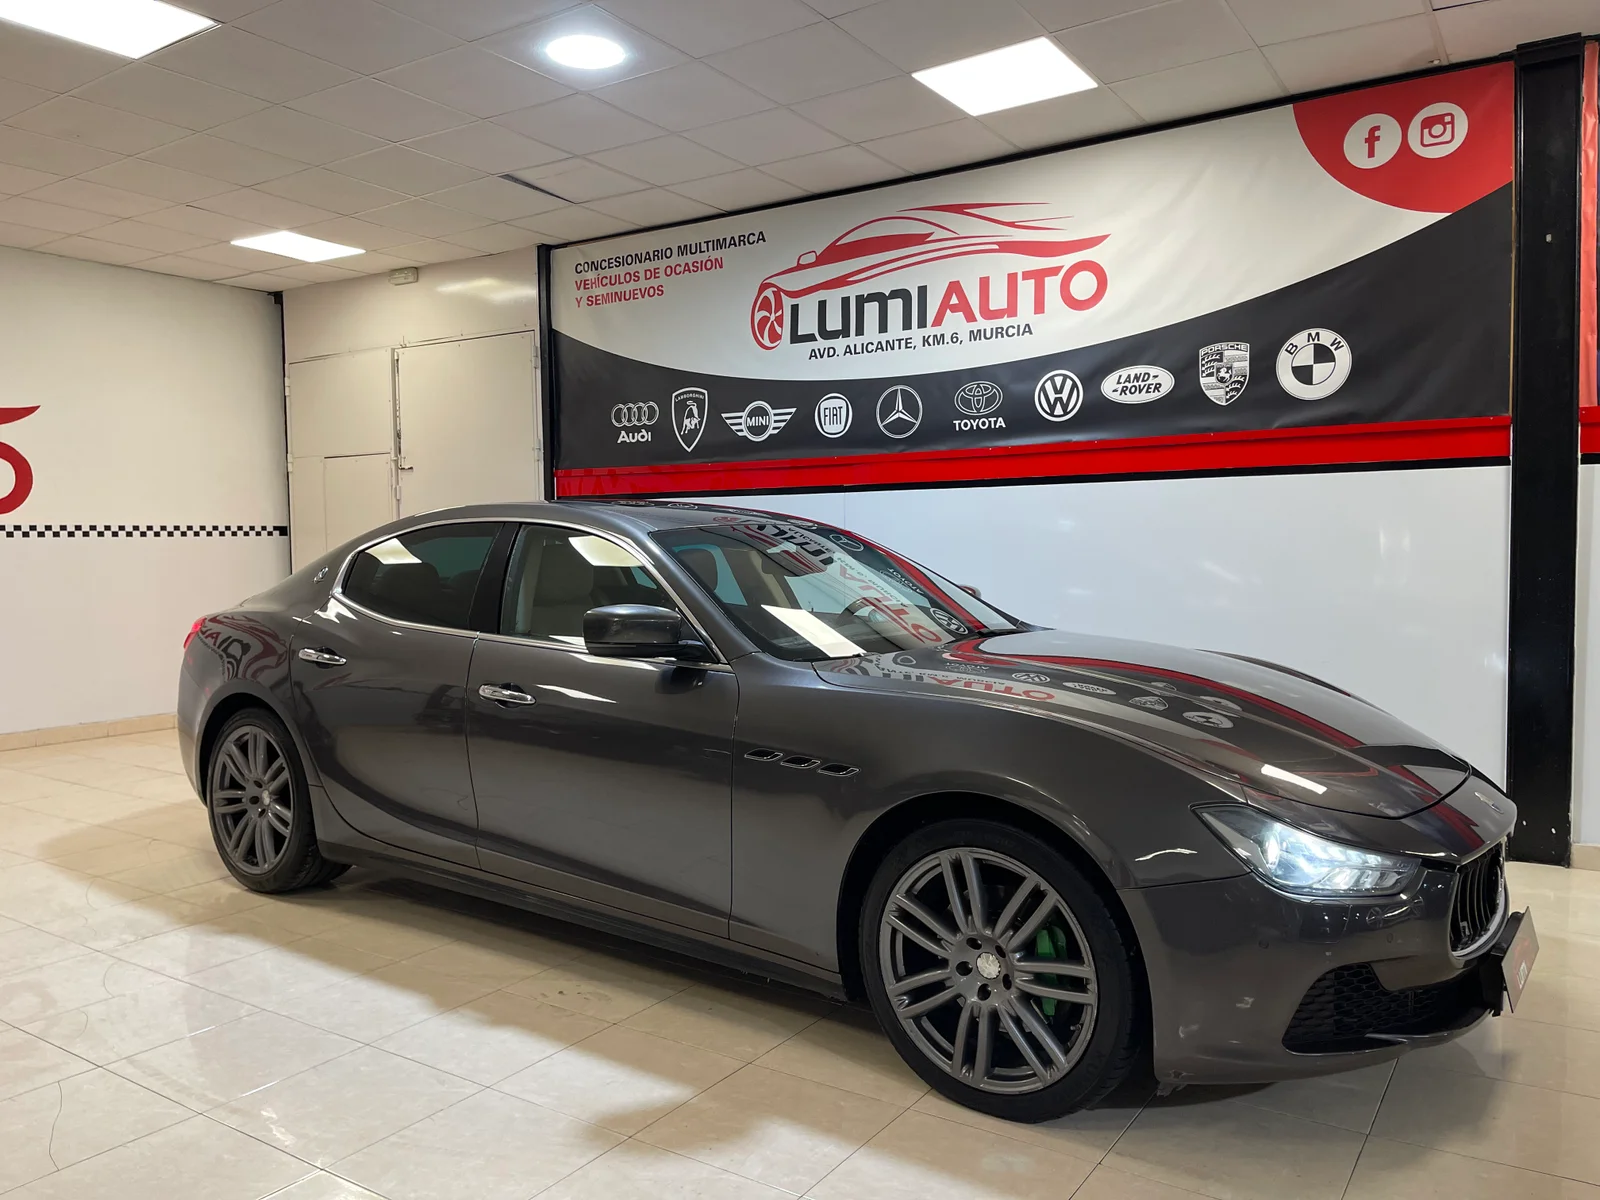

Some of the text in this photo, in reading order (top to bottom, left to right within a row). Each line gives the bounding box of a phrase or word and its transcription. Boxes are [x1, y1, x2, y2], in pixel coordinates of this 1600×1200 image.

[574, 230, 767, 275] CONCESIONARIO MULTIMARCA
[574, 256, 724, 292] VEHÍCULOS DE OCASIÓN
[575, 284, 665, 308] Y SEMINUEVOS
[808, 323, 1033, 360] AVD. ALICANTE, KM.6, MURCIA
[1200, 342, 1249, 357] PORSCHE
[746, 415, 770, 428] MINI
[823, 405, 844, 427] FIAT
[953, 416, 1007, 432] TOYOTA
[616, 428, 652, 444] Audi
